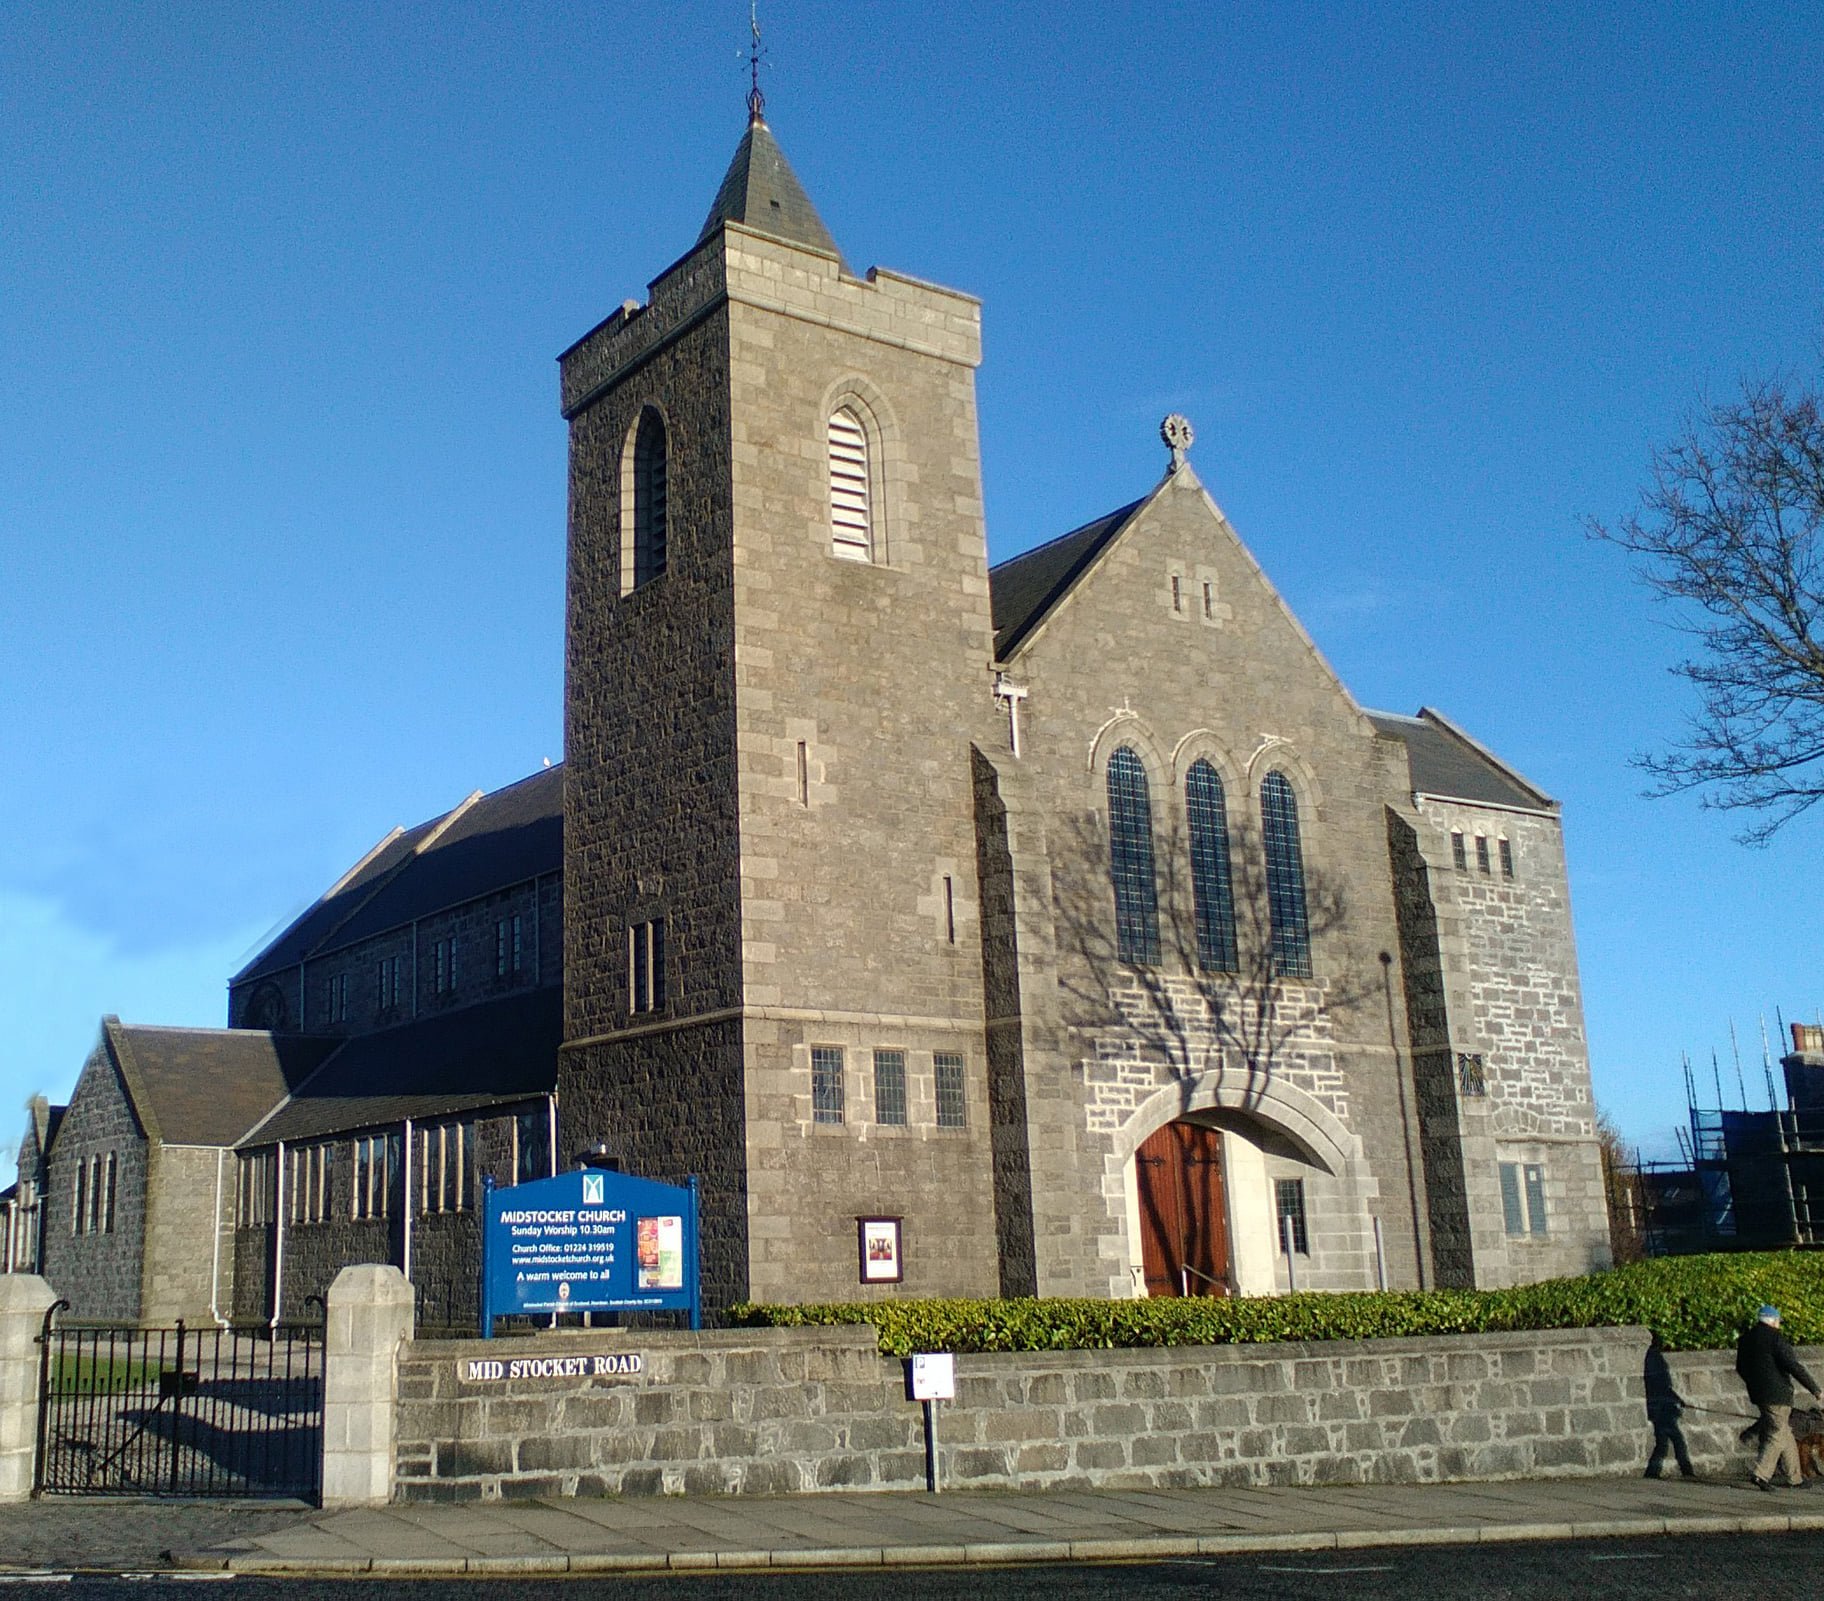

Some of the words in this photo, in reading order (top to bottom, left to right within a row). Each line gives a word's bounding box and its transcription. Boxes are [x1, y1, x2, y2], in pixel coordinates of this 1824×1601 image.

[501, 1211, 575, 1223] MIDSTOCKET
[578, 1210, 626, 1222] CHURCH
[511, 1225, 542, 1238] Sunday
[543, 1225, 578, 1236] Worship
[579, 1224, 615, 1235] 10.30am
[512, 1244, 538, 1253] Church
[538, 1244, 563, 1253] Office:
[564, 1243, 587, 1253] 01224
[512, 1253, 615, 1265] www.midstocketchurch.org.uk
[516, 1271, 525, 1281] A
[526, 1272, 550, 1281] warm
[551, 1270, 588, 1280] welcome
[589, 1269, 599, 1279] to
[600, 1269, 610, 1279] all
[468, 1361, 504, 1381] MID
[509, 1358, 587, 1379] STOCKET
[594, 1355, 642, 1375] ROAD
